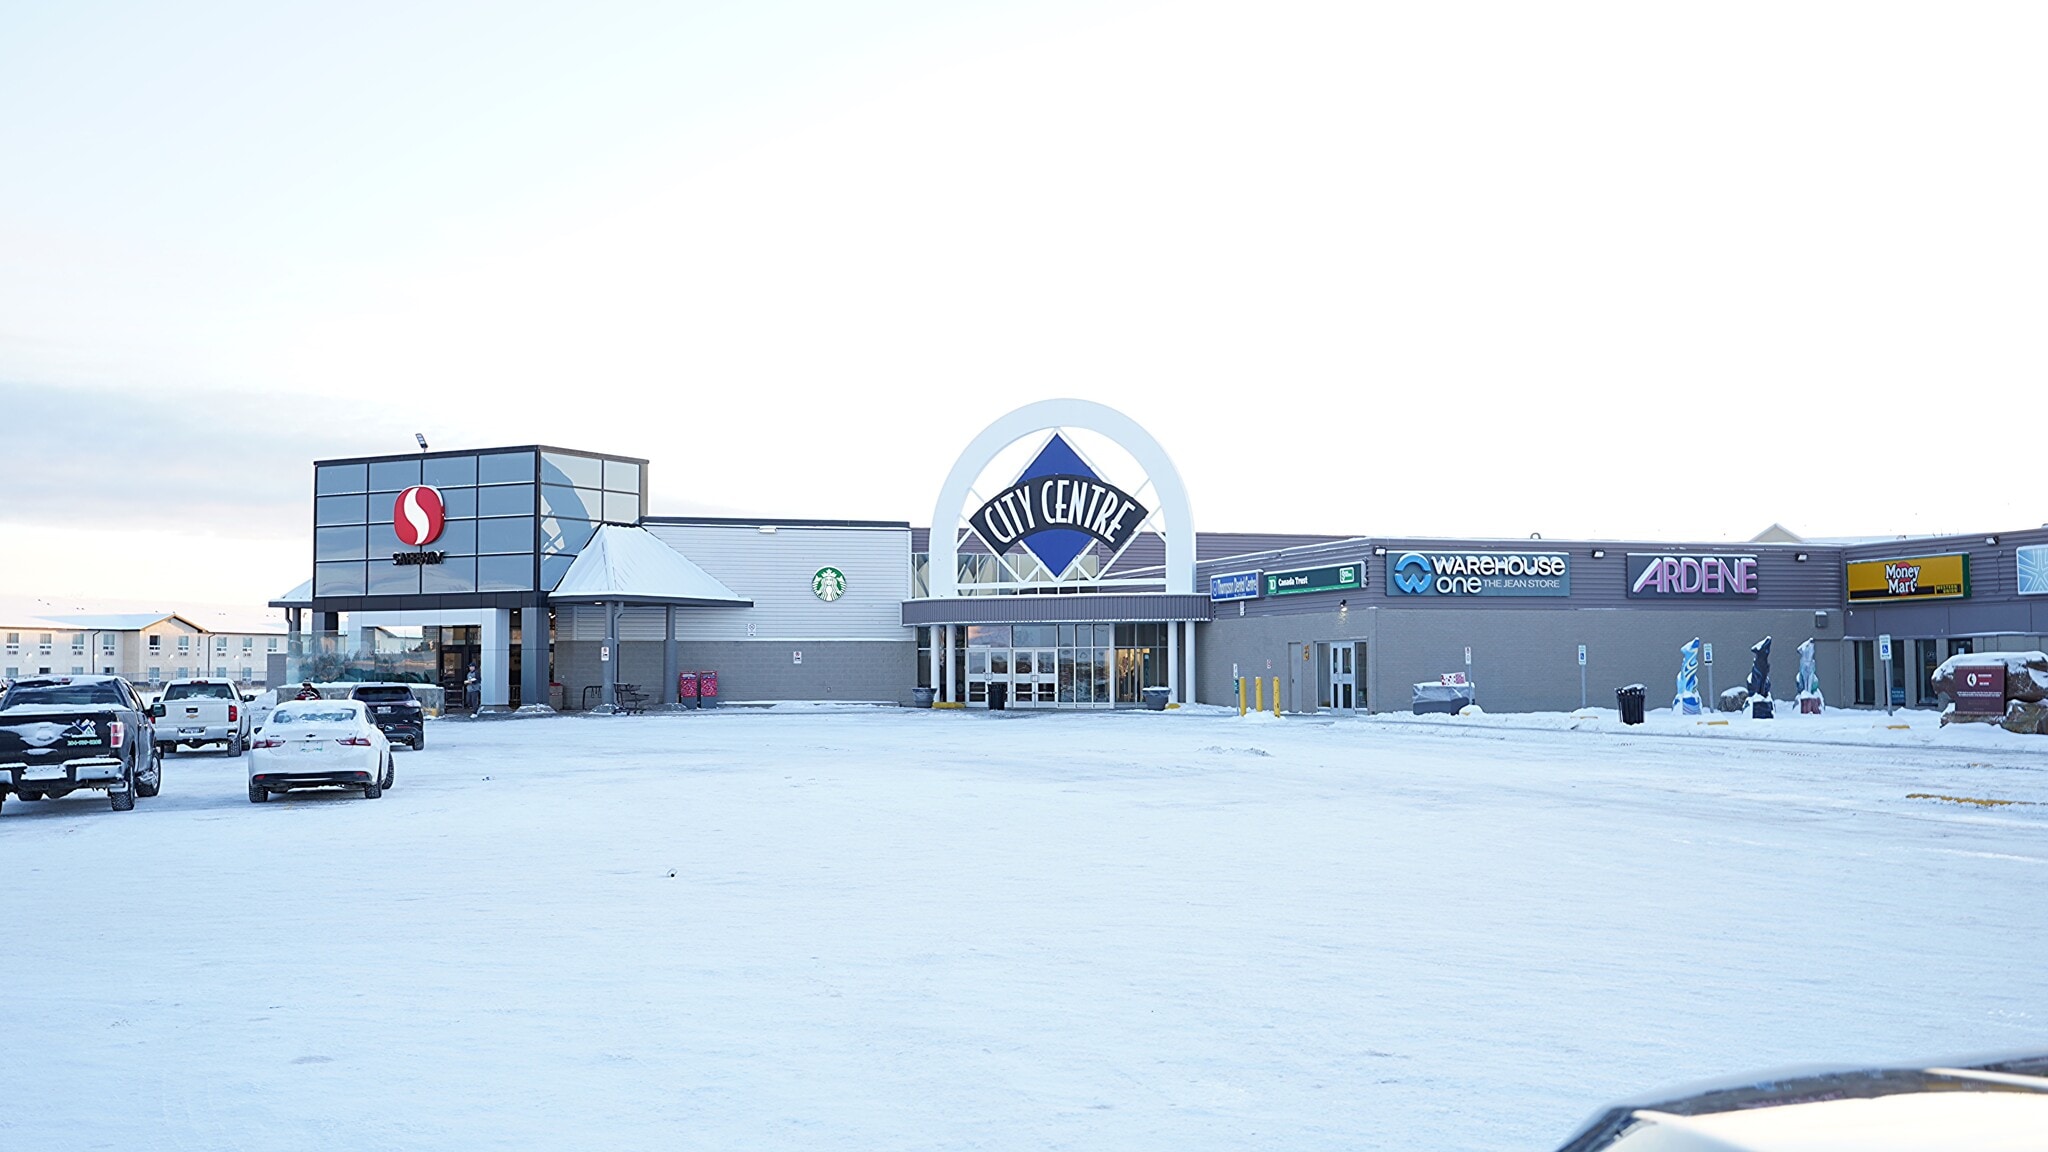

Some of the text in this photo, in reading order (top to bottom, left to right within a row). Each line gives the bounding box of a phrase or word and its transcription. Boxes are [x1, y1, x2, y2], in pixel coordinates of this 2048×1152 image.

[984, 479, 1136, 543] CITY CENTRE
[1278, 577, 1294, 586] Canada
[1295, 575, 1308, 585] Trust
[1632, 557, 1758, 593] ARDENE
[1885, 564, 1920, 581] Money
[1436, 576, 1482, 593] one
[1483, 579, 1560, 588] THE JEAN STORE
[1888, 579, 1916, 594] Mart
